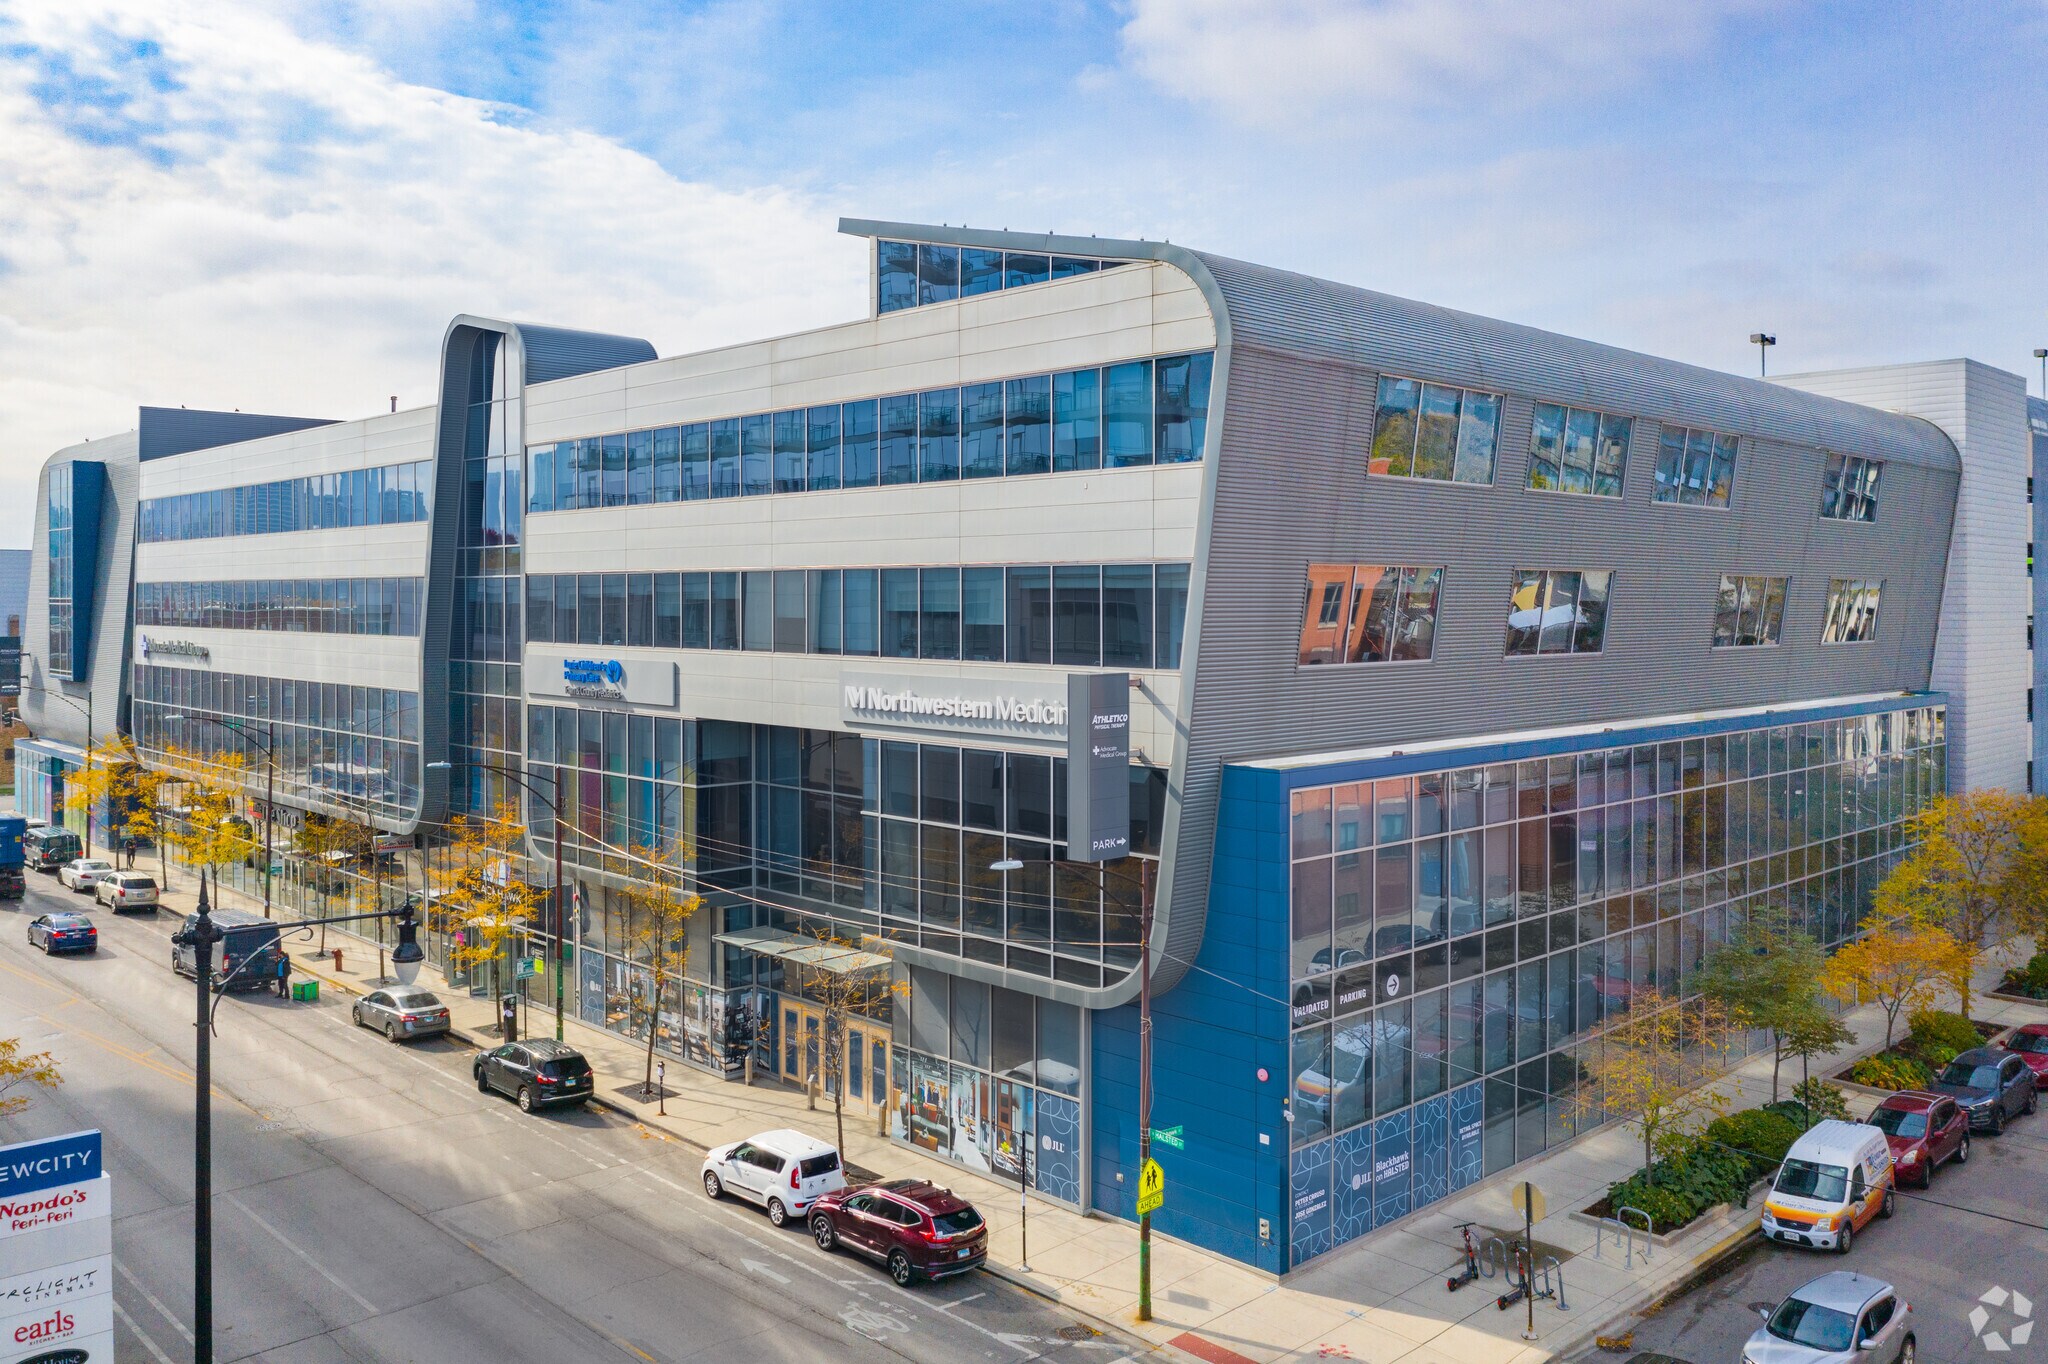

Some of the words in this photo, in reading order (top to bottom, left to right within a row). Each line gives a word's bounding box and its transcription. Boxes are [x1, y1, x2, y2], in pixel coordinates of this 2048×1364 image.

[868, 687, 992, 719] Northwestern
[996, 695, 1068, 725] Medicin
[1092, 714, 1128, 724] ATHLETICO
[1093, 838, 1116, 850] PARK
[1294, 1000, 1329, 1018] VALIDATED
[1340, 989, 1367, 1004] PARKING
[1052, 1140, 1064, 1153] JLL
[0, 1150, 92, 1182] EWCITY
[1376, 1151, 1409, 1172] Blackhawk
[1376, 1174, 1383, 1182] on
[1383, 1161, 1409, 1179] HALSTED
[0, 1189, 86, 1219] Nando's
[1140, 1197, 1160, 1210] AHEAD
[12, 1208, 72, 1231] Peri-Peri
[24, 1281, 94, 1303] CINEMAS
[14, 1310, 75, 1343] earls
